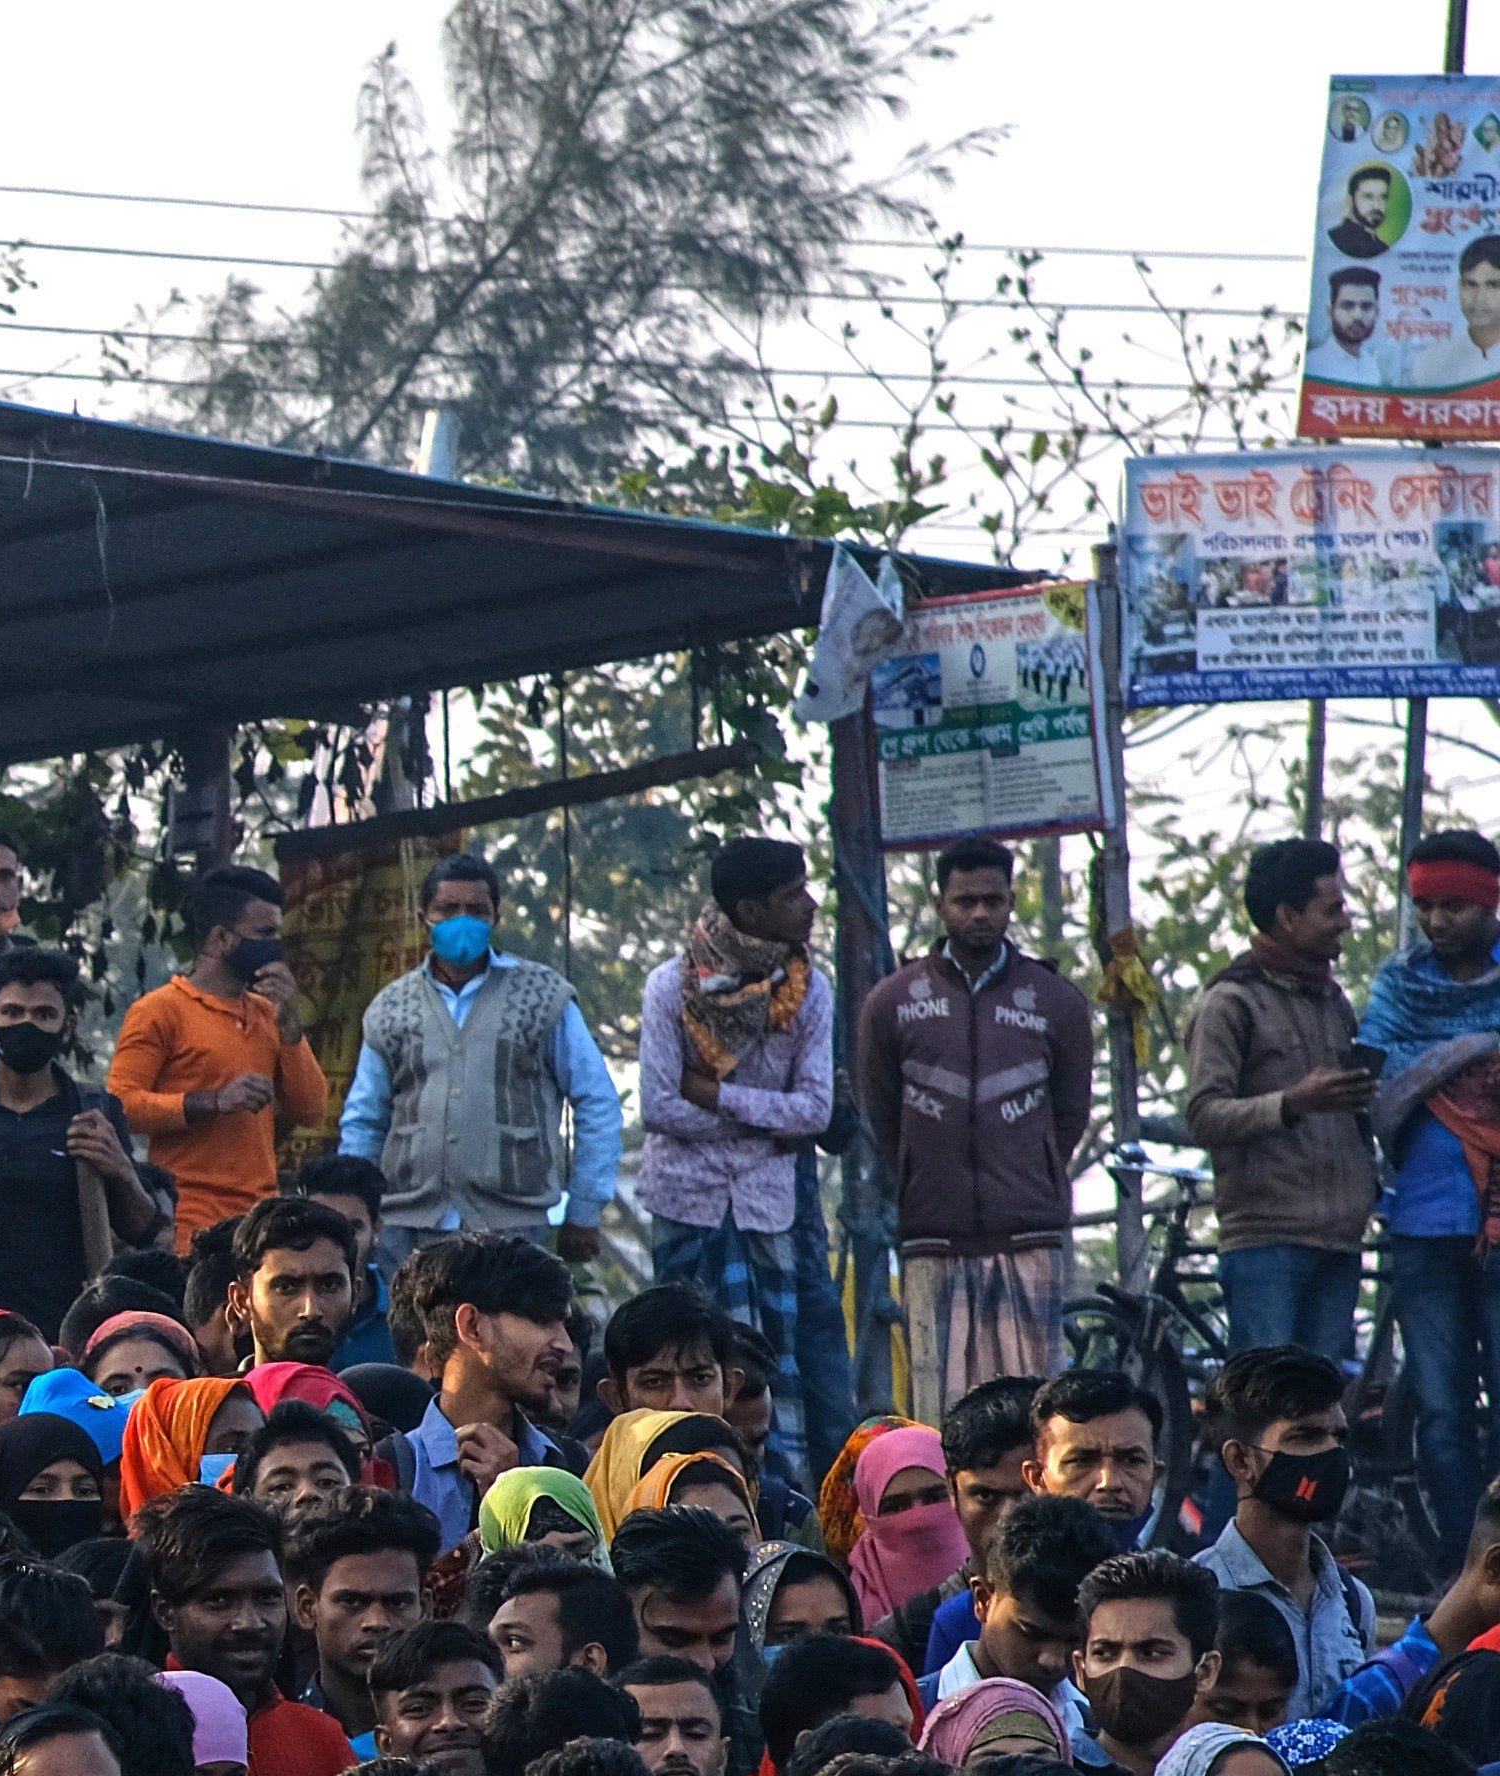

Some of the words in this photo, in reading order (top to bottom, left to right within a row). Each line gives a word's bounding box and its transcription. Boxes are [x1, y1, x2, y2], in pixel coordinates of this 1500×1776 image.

[1424, 172, 1500, 203] শারদী
[1139, 469, 1208, 526] ভাই
[1213, 467, 1283, 526] ভাই
[1290, 463, 1378, 526] ট্রেনিং
[1389, 462, 1494, 522] সেন্টার
[896, 998, 951, 1024] PHONE
[994, 1006, 1049, 1035] PHONE
